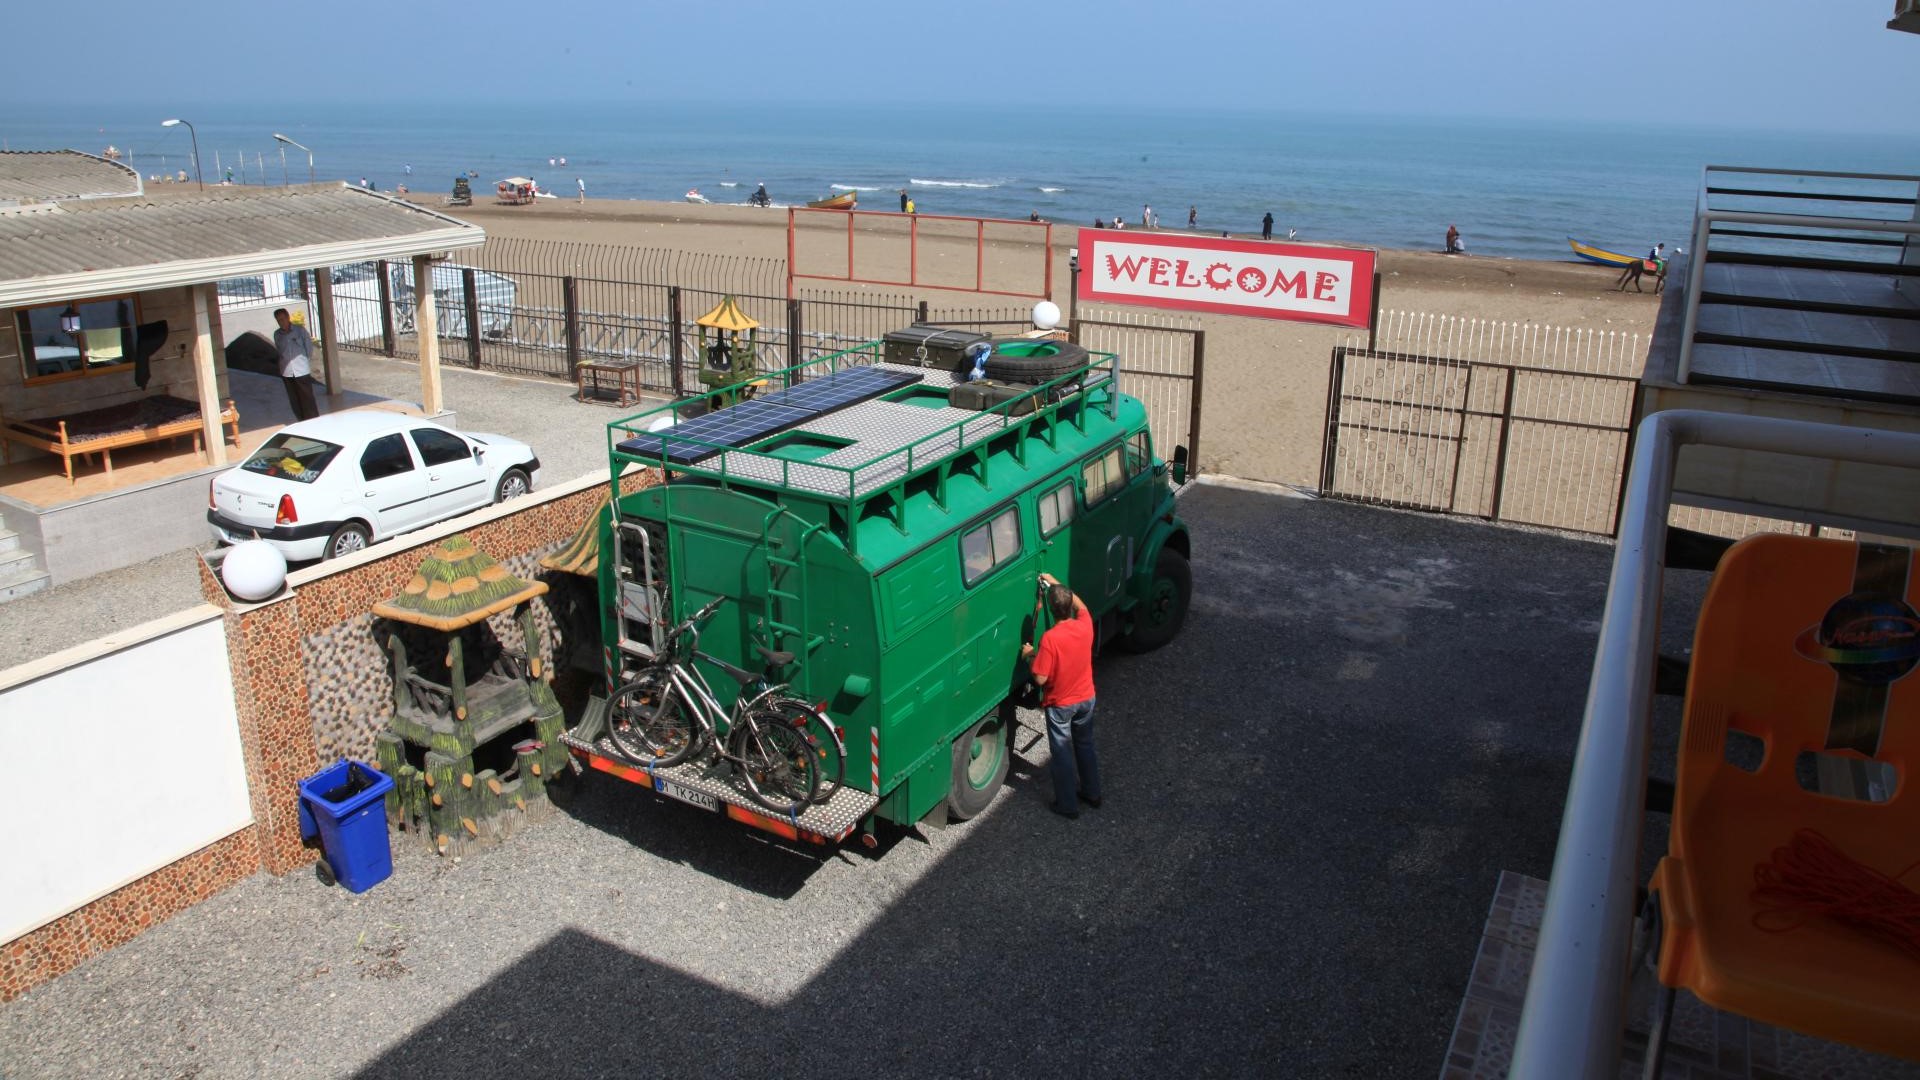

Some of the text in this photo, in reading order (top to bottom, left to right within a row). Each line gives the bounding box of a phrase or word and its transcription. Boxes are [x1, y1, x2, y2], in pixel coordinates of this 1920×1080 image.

[1105, 254, 1340, 302] WELCOME
[674, 785, 687, 800] TK
[688, 790, 715, 809] 214H
